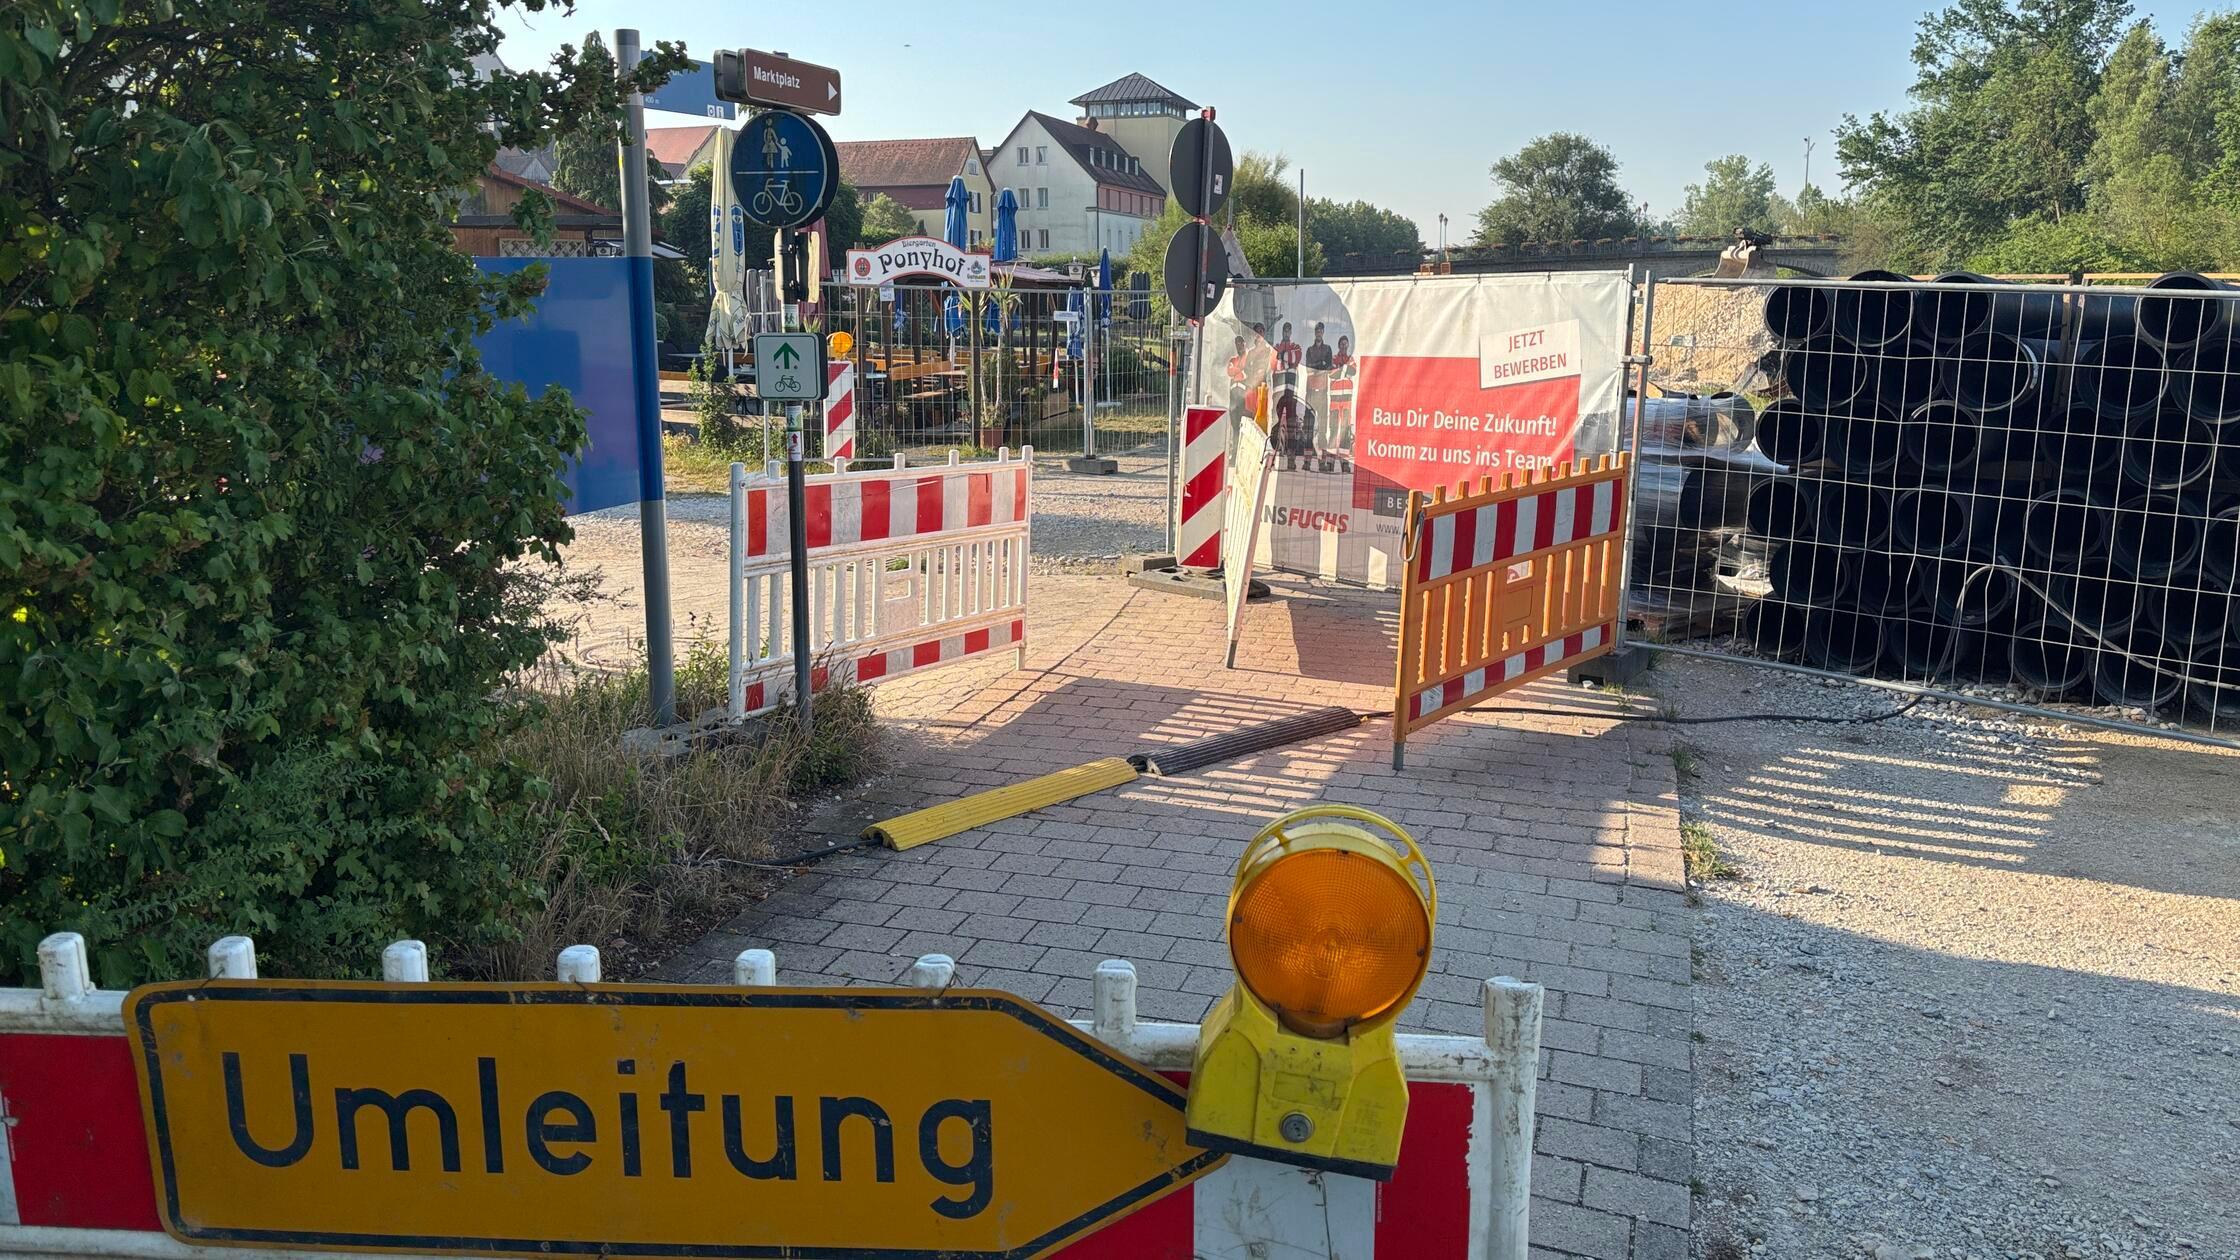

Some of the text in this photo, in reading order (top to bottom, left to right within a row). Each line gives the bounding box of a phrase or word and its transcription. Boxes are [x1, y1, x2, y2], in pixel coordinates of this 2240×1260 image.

[753, 66, 801, 89] Marktplatz
[878, 248, 966, 276] Ponyhof
[1508, 330, 1545, 352] JETZT
[1494, 353, 1567, 379] BEWERBEN
[1372, 408, 1557, 436] Bau Dir Deine Zukunft!
[1367, 439, 1415, 459] Komm
[1419, 447, 1437, 462] zu
[1442, 449, 1470, 465] uns
[1475, 444, 1500, 467] ins
[1260, 505, 1350, 533] NSFUCHS
[223, 1051, 995, 1219] Umleitung
